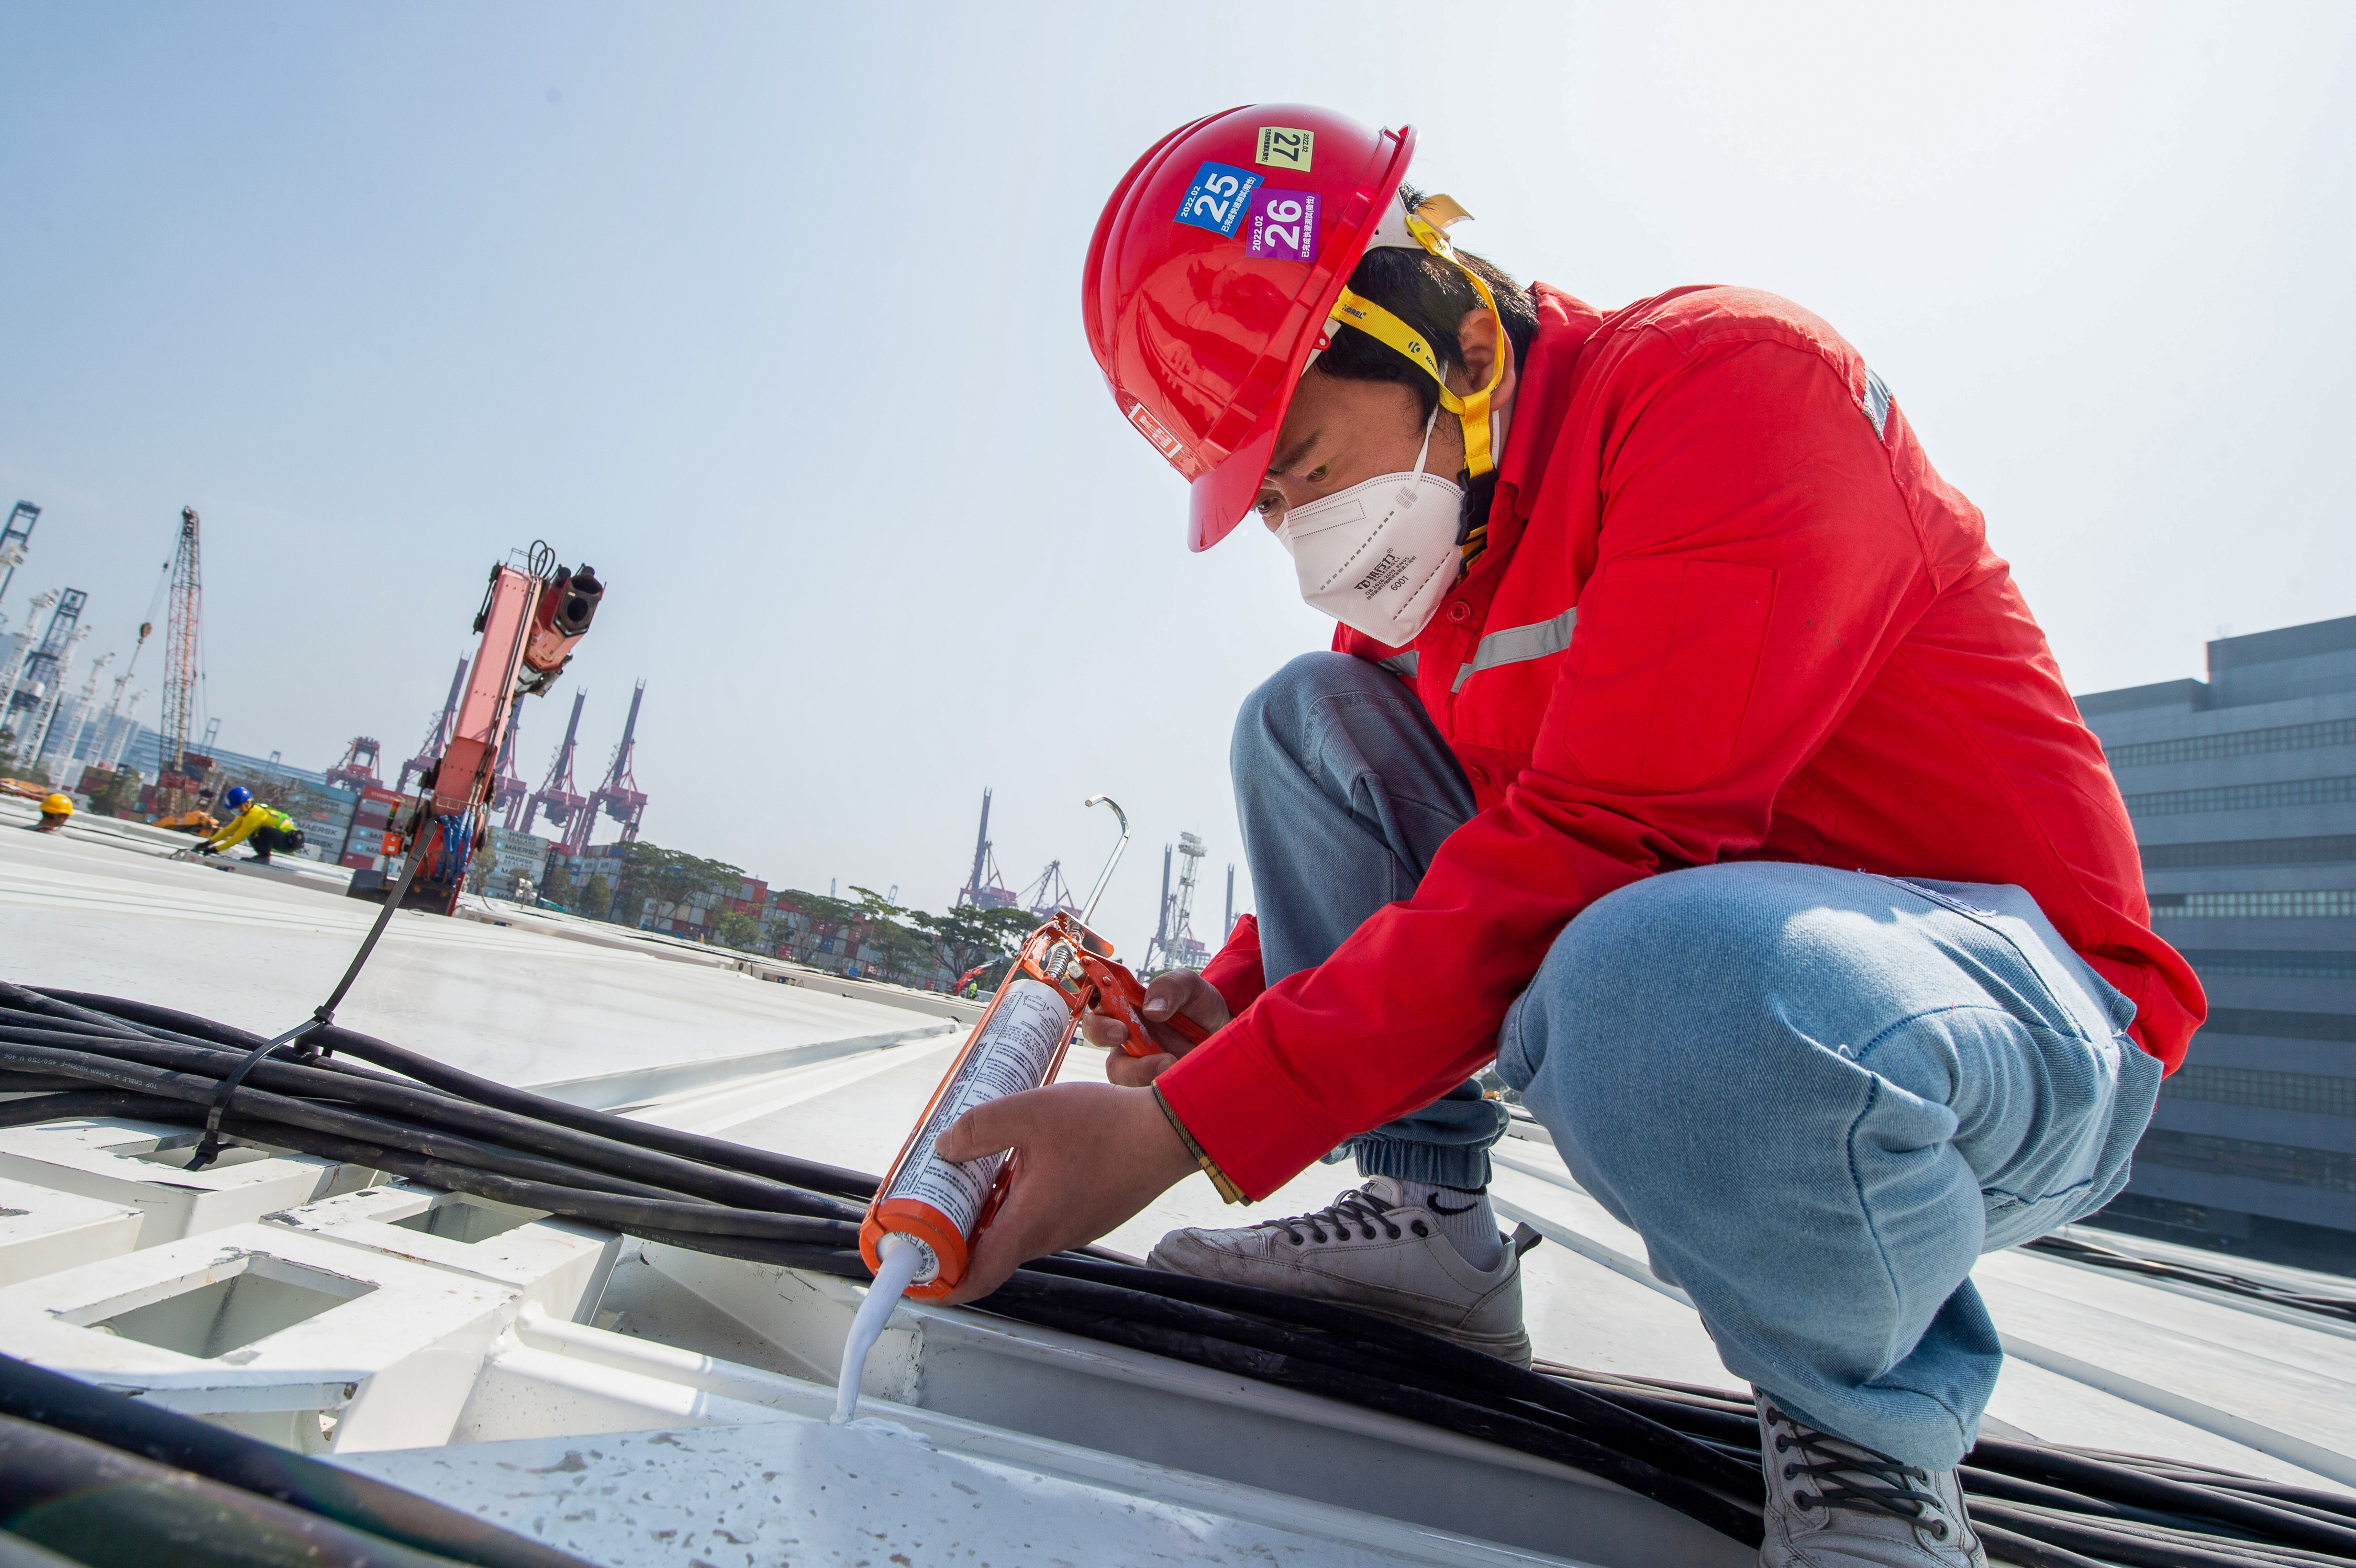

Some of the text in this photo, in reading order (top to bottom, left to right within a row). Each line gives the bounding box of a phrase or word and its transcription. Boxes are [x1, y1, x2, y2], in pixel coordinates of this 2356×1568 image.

[1273, 132, 1301, 162] 27
[1181, 186, 1201, 217] 2022.02
[1194, 173, 1238, 223] 25
[1264, 199, 1302, 250] 26
[1252, 216, 1263, 251] 2022.02
[1373, 570, 1395, 589] 2626-2019
[1396, 557, 1409, 569] KN95
[1391, 575, 1409, 591] 6001
[508, 832, 537, 841] MAERSK
[307, 837, 334, 849] ERSK
[504, 844, 539, 856] MAERSK
[505, 854, 533, 864] MAERSK
[28, 1057, 57, 1065] 450/750
[60, 1061, 88, 1072] H07RN-F
[90, 1069, 110, 1077] Xtrem
[122, 1076, 142, 1085] CABLE
